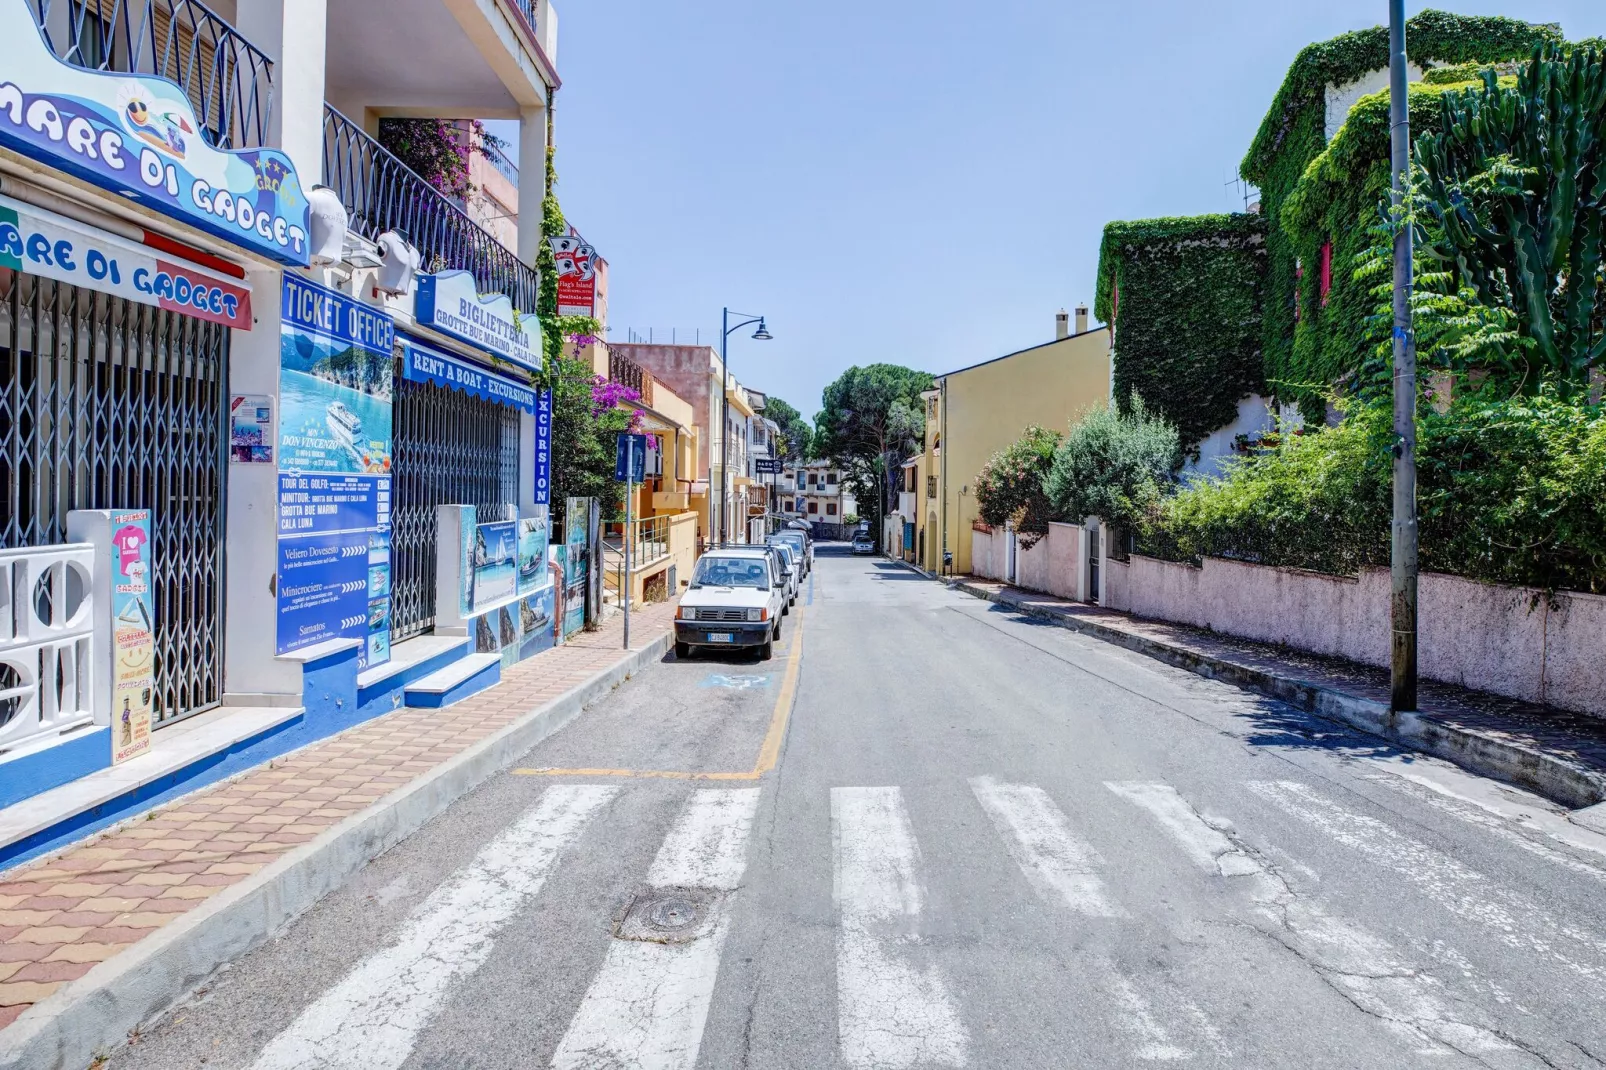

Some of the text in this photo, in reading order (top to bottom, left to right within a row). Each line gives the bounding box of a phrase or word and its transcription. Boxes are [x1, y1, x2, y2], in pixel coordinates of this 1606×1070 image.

[140, 149, 178, 195] DI
[192, 179, 305, 254] GADGET
[86, 250, 120, 284] DI
[134, 269, 238, 319] GADGET
[287, 282, 391, 350] TICKET OFFICE
[459, 298, 529, 349] BIGLIETTERIA
[436, 309, 468, 334] GROTTE
[469, 325, 482, 341] BUE
[484, 332, 509, 353] MARINO
[514, 346, 527, 361] CALA
[413, 353, 444, 377] RENT
[446, 365, 454, 380] A
[456, 367, 482, 389] BOAT
[488, 379, 533, 406] EXCURSIONS
[282, 435, 338, 450] DON VINCENZO
[282, 478, 297, 489] TOUR
[299, 479, 309, 489] DEL
[311, 479, 329, 489] GOLFO:
[282, 493, 310, 503] MINITOUR:
[282, 505, 338, 516] GROTTA BUE MARINO
[282, 518, 313, 529] CALA LUNA
[285, 548, 308, 559] Veliero
[281, 583, 322, 598] Minicrociere
